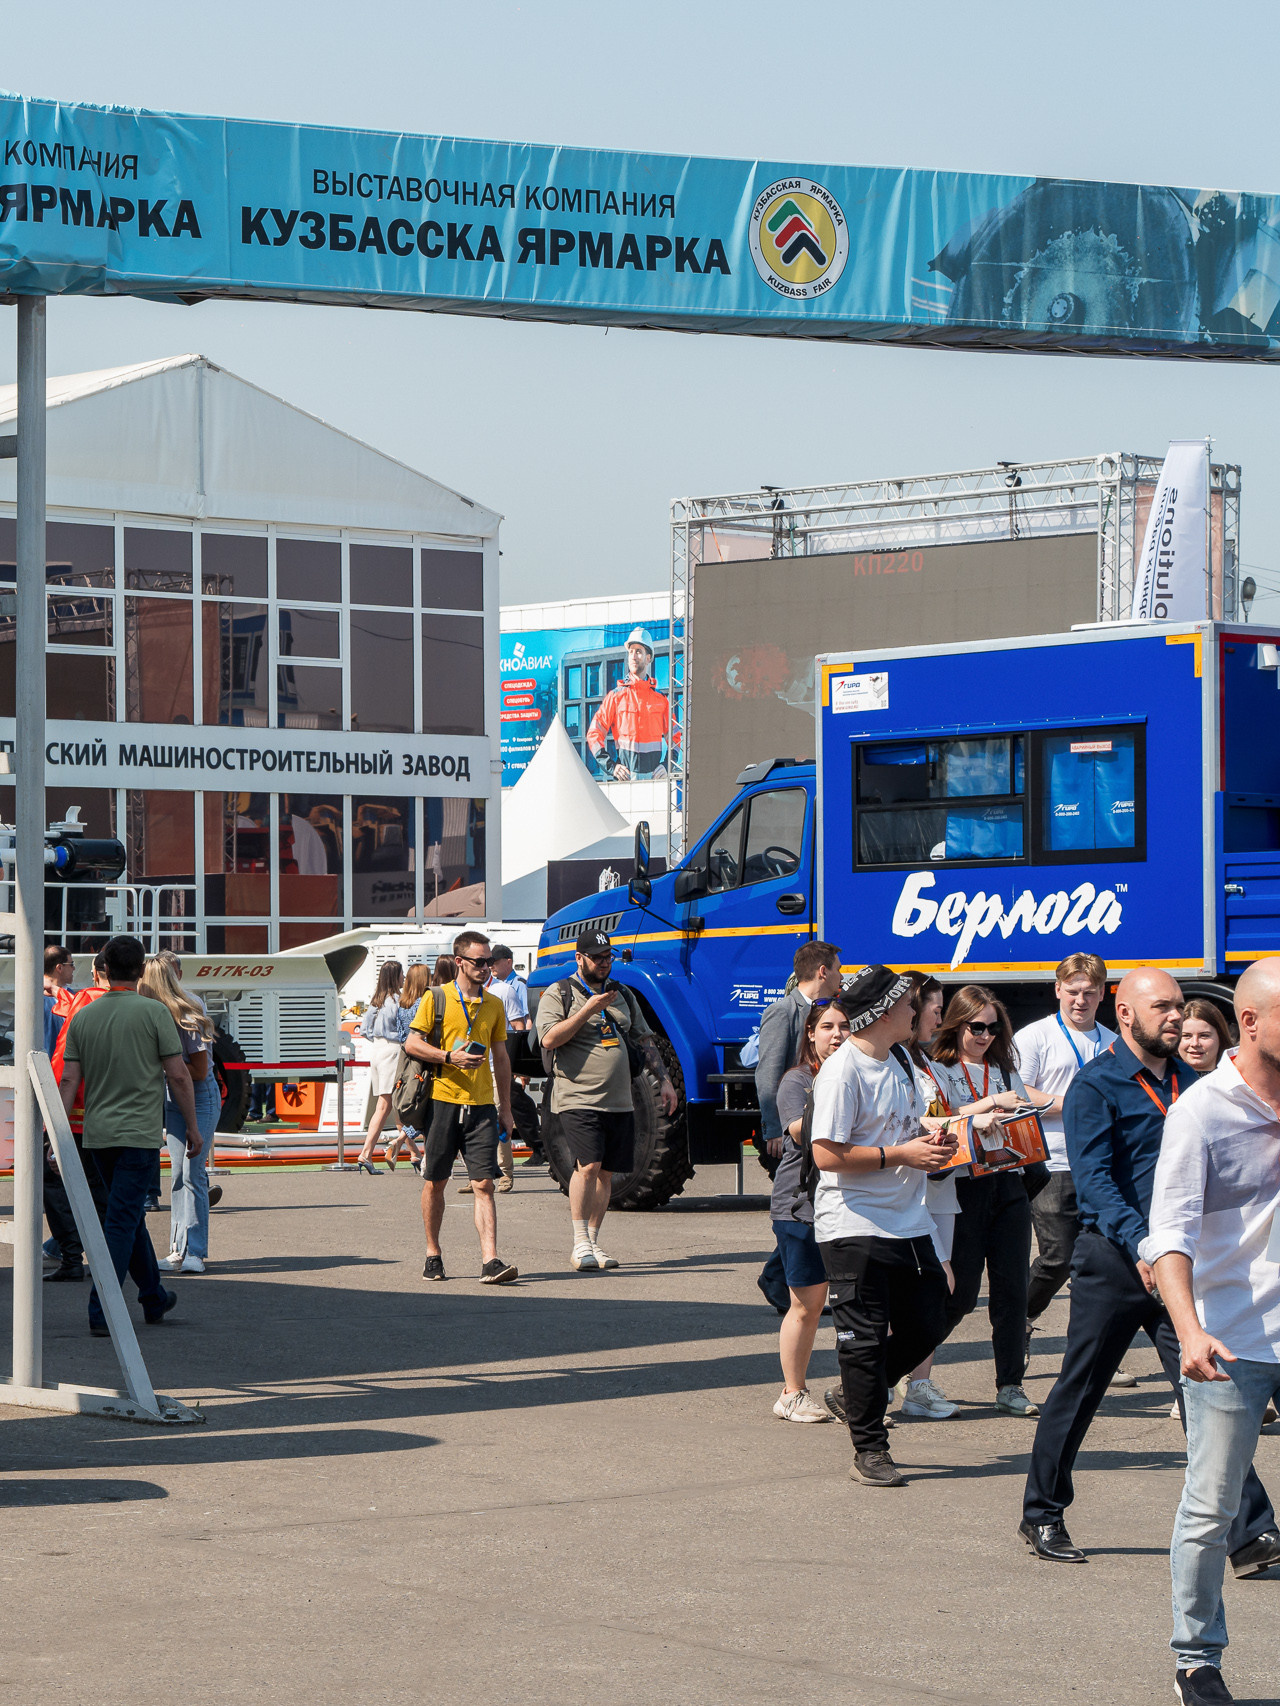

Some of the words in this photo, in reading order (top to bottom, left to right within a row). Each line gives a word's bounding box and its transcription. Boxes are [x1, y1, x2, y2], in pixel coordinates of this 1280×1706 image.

[5, 139, 138, 180] КОМПАНИЯ
[313, 168, 515, 208] ВЫСТАВОЧНАЯ
[525, 185, 676, 218] КОМПАНИЯ
[753, 180, 801, 221] КУЗБАССКАЯ
[810, 184, 844, 226] ЯРМАРКА
[241, 206, 505, 263] КУЗБАССКА
[517, 227, 731, 274] ЯРМАРКА
[767, 275, 808, 296] KUZBASS
[812, 278, 832, 294] FAIR
[119, 744, 393, 774] МАШИНОСТРОИТЕЛЬНЫЙ
[402, 753, 471, 781] ЗАВОД
[891, 870, 1123, 971] Берлога
[196, 965, 275, 977] B17K-03
